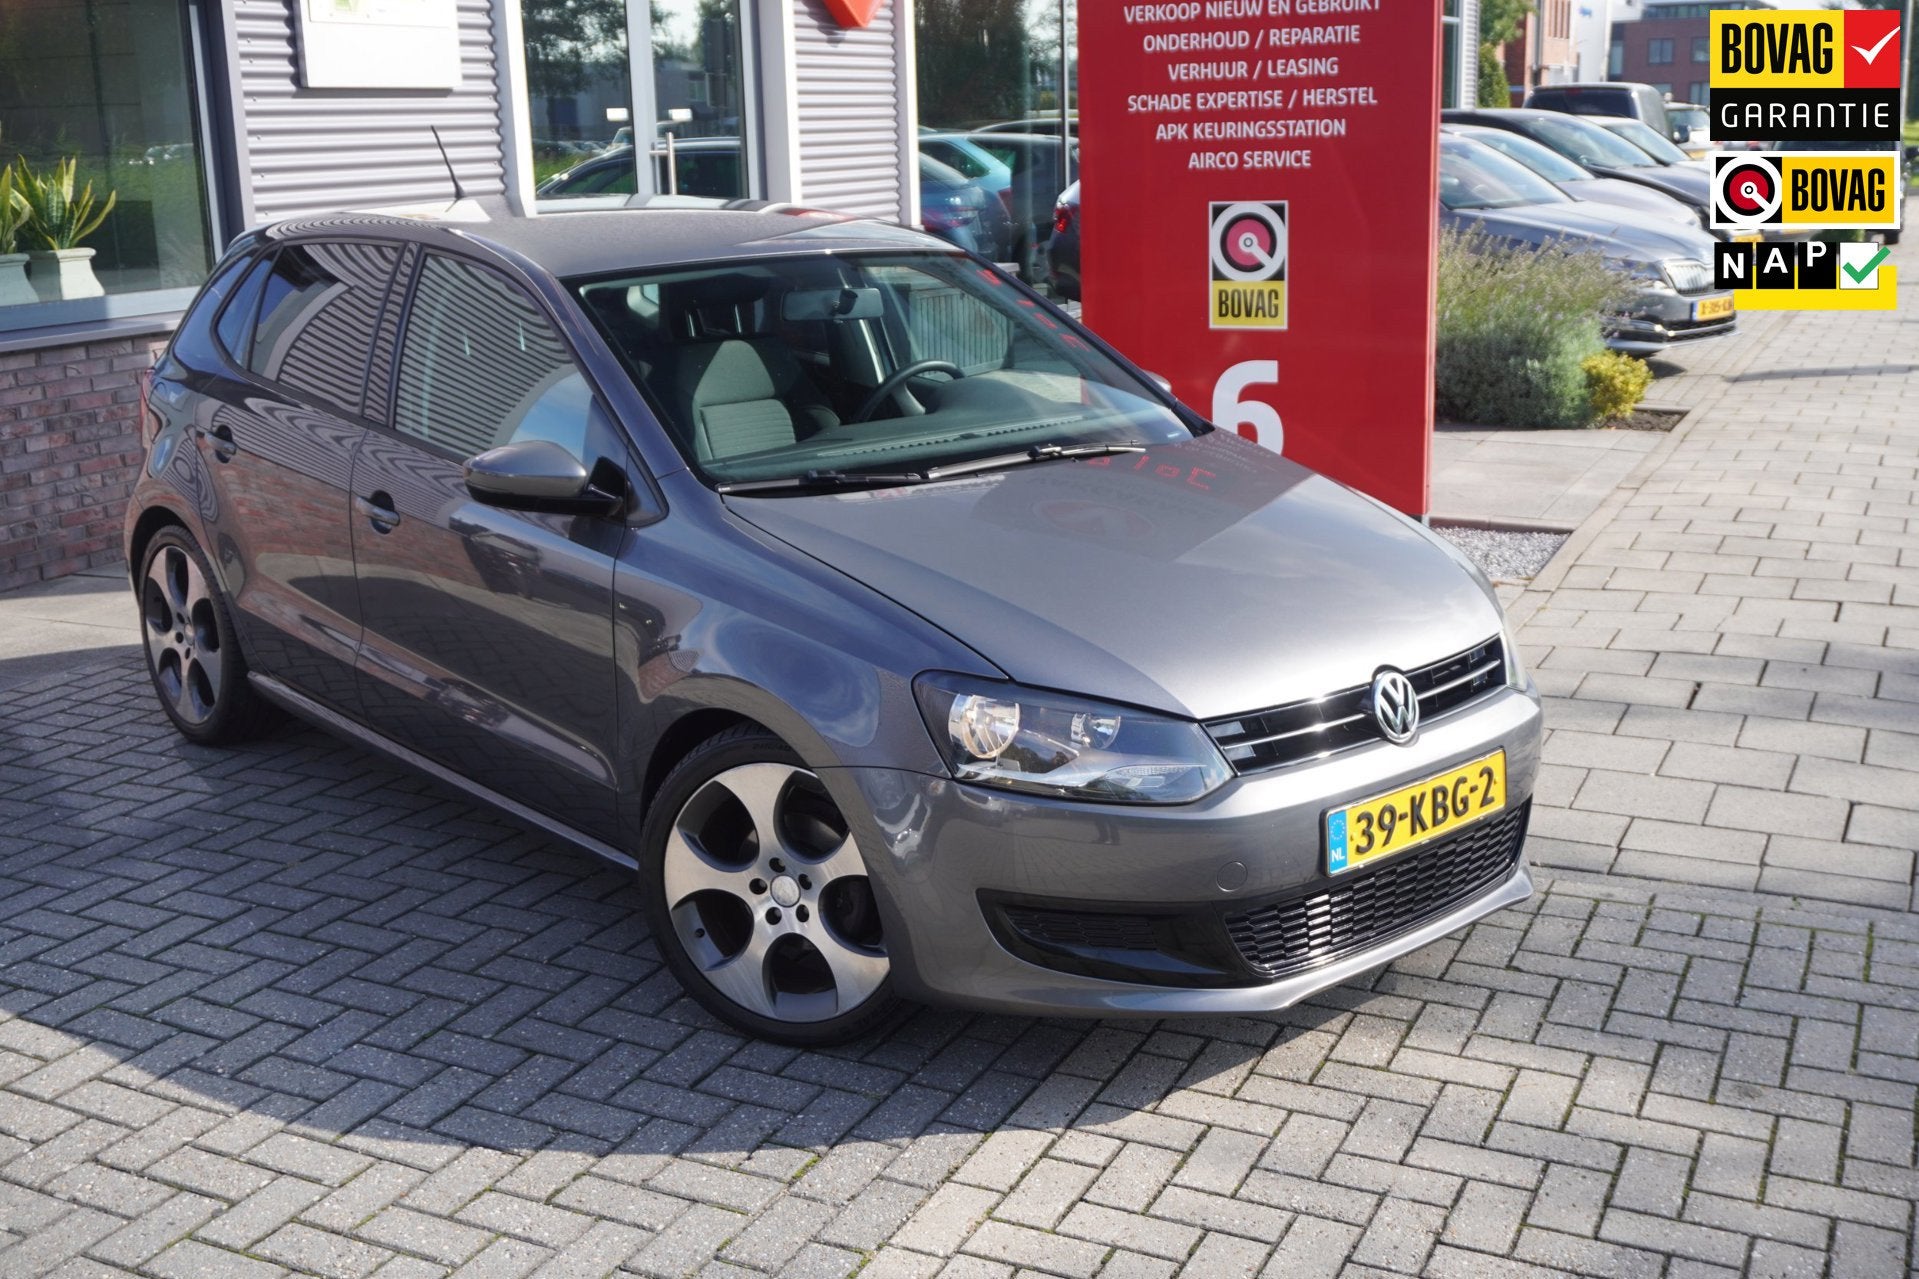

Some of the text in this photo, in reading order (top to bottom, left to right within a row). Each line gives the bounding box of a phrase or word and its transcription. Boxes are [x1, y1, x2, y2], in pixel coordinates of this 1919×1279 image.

[1123, 2, 1201, 23] VERKOOP
[1205, 0, 1263, 19] NIEUW
[1267, 0, 1291, 16] EN
[1143, 30, 1250, 53] ONDERHOUD
[1269, 24, 1361, 46] REPARATIE
[1167, 60, 1248, 81] VERHUUR
[1267, 56, 1339, 78] LEASING
[1127, 93, 1192, 112] SCHADE
[1196, 89, 1283, 110] EXPERTISE
[1302, 86, 1378, 107] HERSTEL
[1155, 118, 1346, 141] APK KEURINGSSTATION
[1188, 149, 1312, 169] AIRCO SERVICE
[1218, 289, 1279, 319] BOVAG
[1212, 359, 1284, 456] 6
[1355, 765, 1496, 855] 39-KBG-2
[1331, 847, 1345, 863] NL
